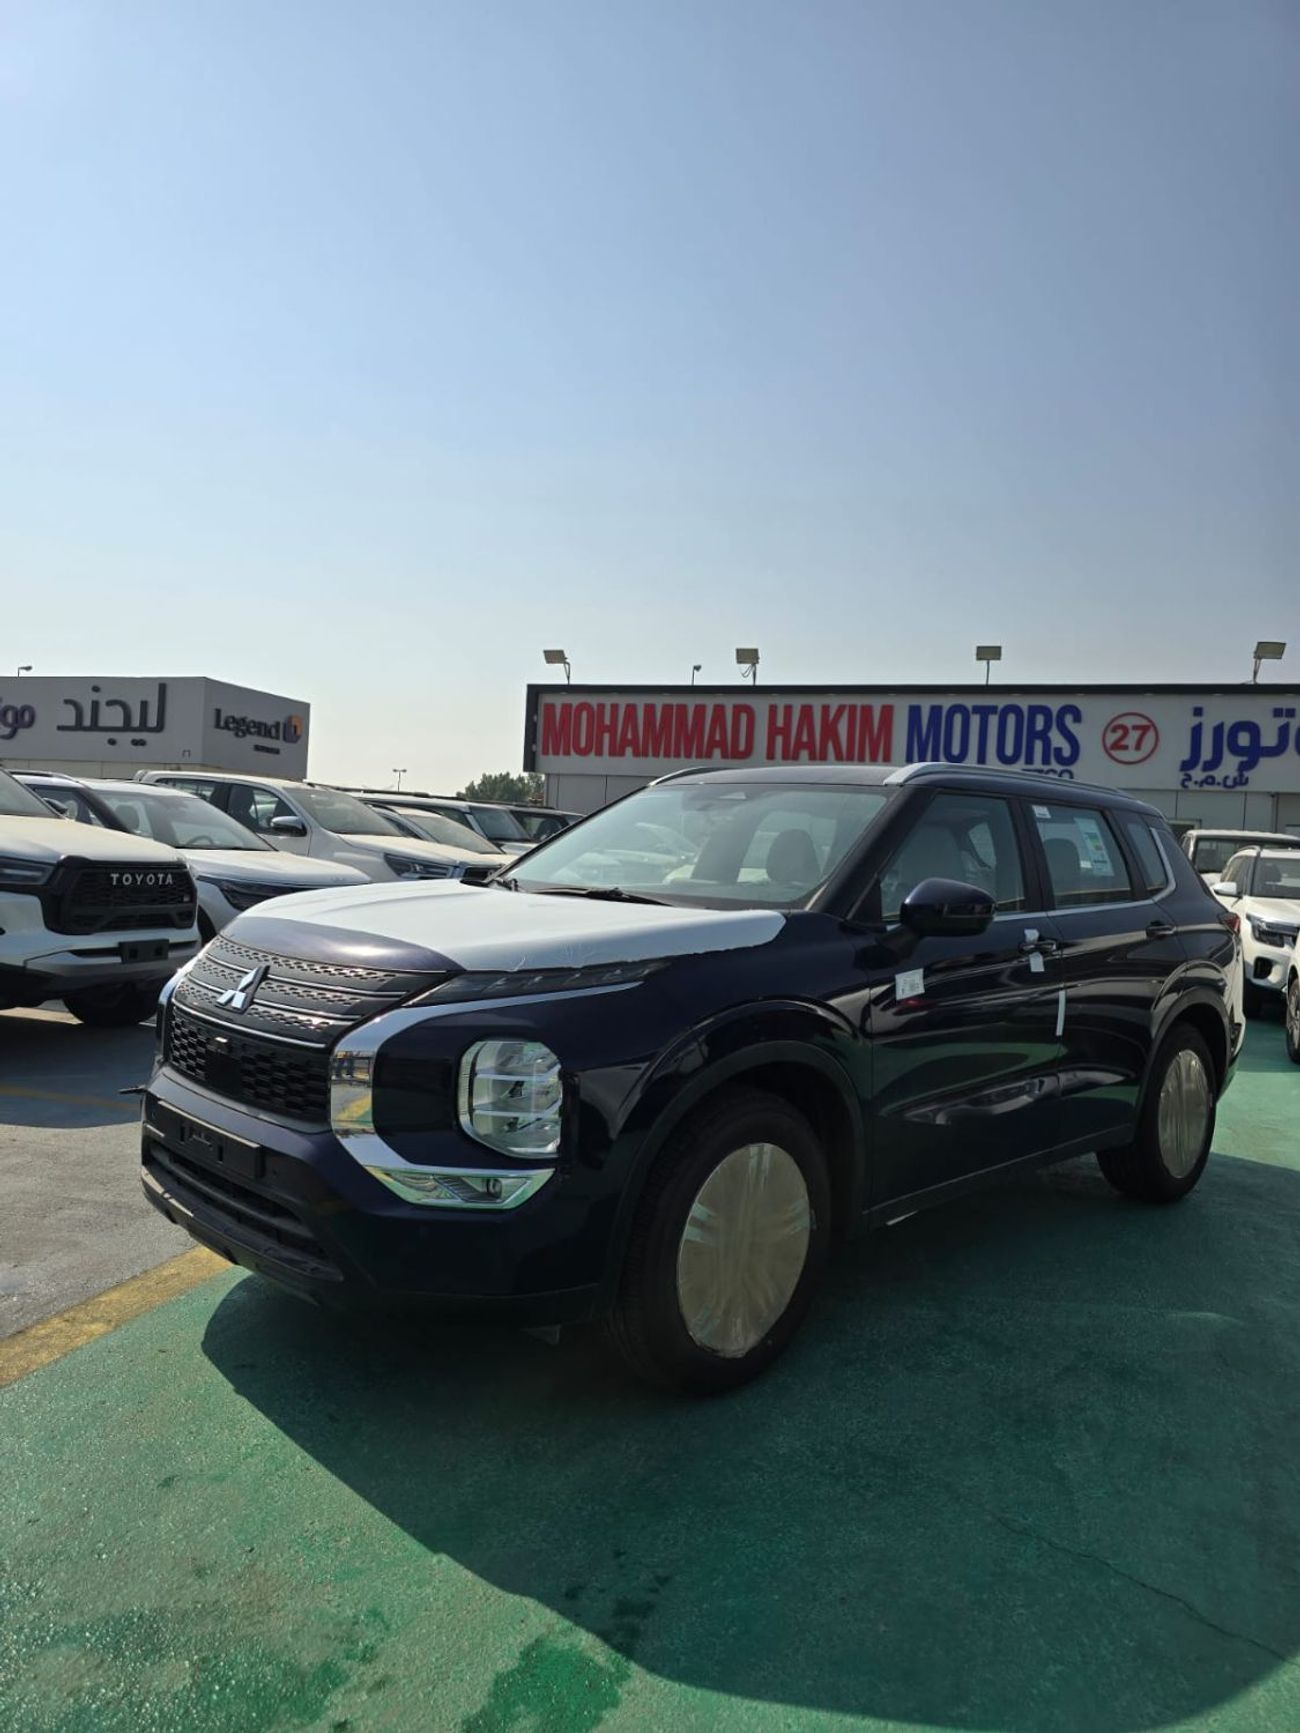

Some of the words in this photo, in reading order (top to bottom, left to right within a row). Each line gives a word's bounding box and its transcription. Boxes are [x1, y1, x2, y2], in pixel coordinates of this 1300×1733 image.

[56, 682, 168, 747] ليجند
[213, 708, 281, 741] Legend
[540, 702, 756, 761] MOHAMMAD
[765, 703, 895, 763] HAKIM
[904, 703, 1082, 767] MOTORS
[1108, 723, 1152, 752] 27
[1178, 705, 1300, 773] تورز
[109, 872, 174, 886] TOYOTA
